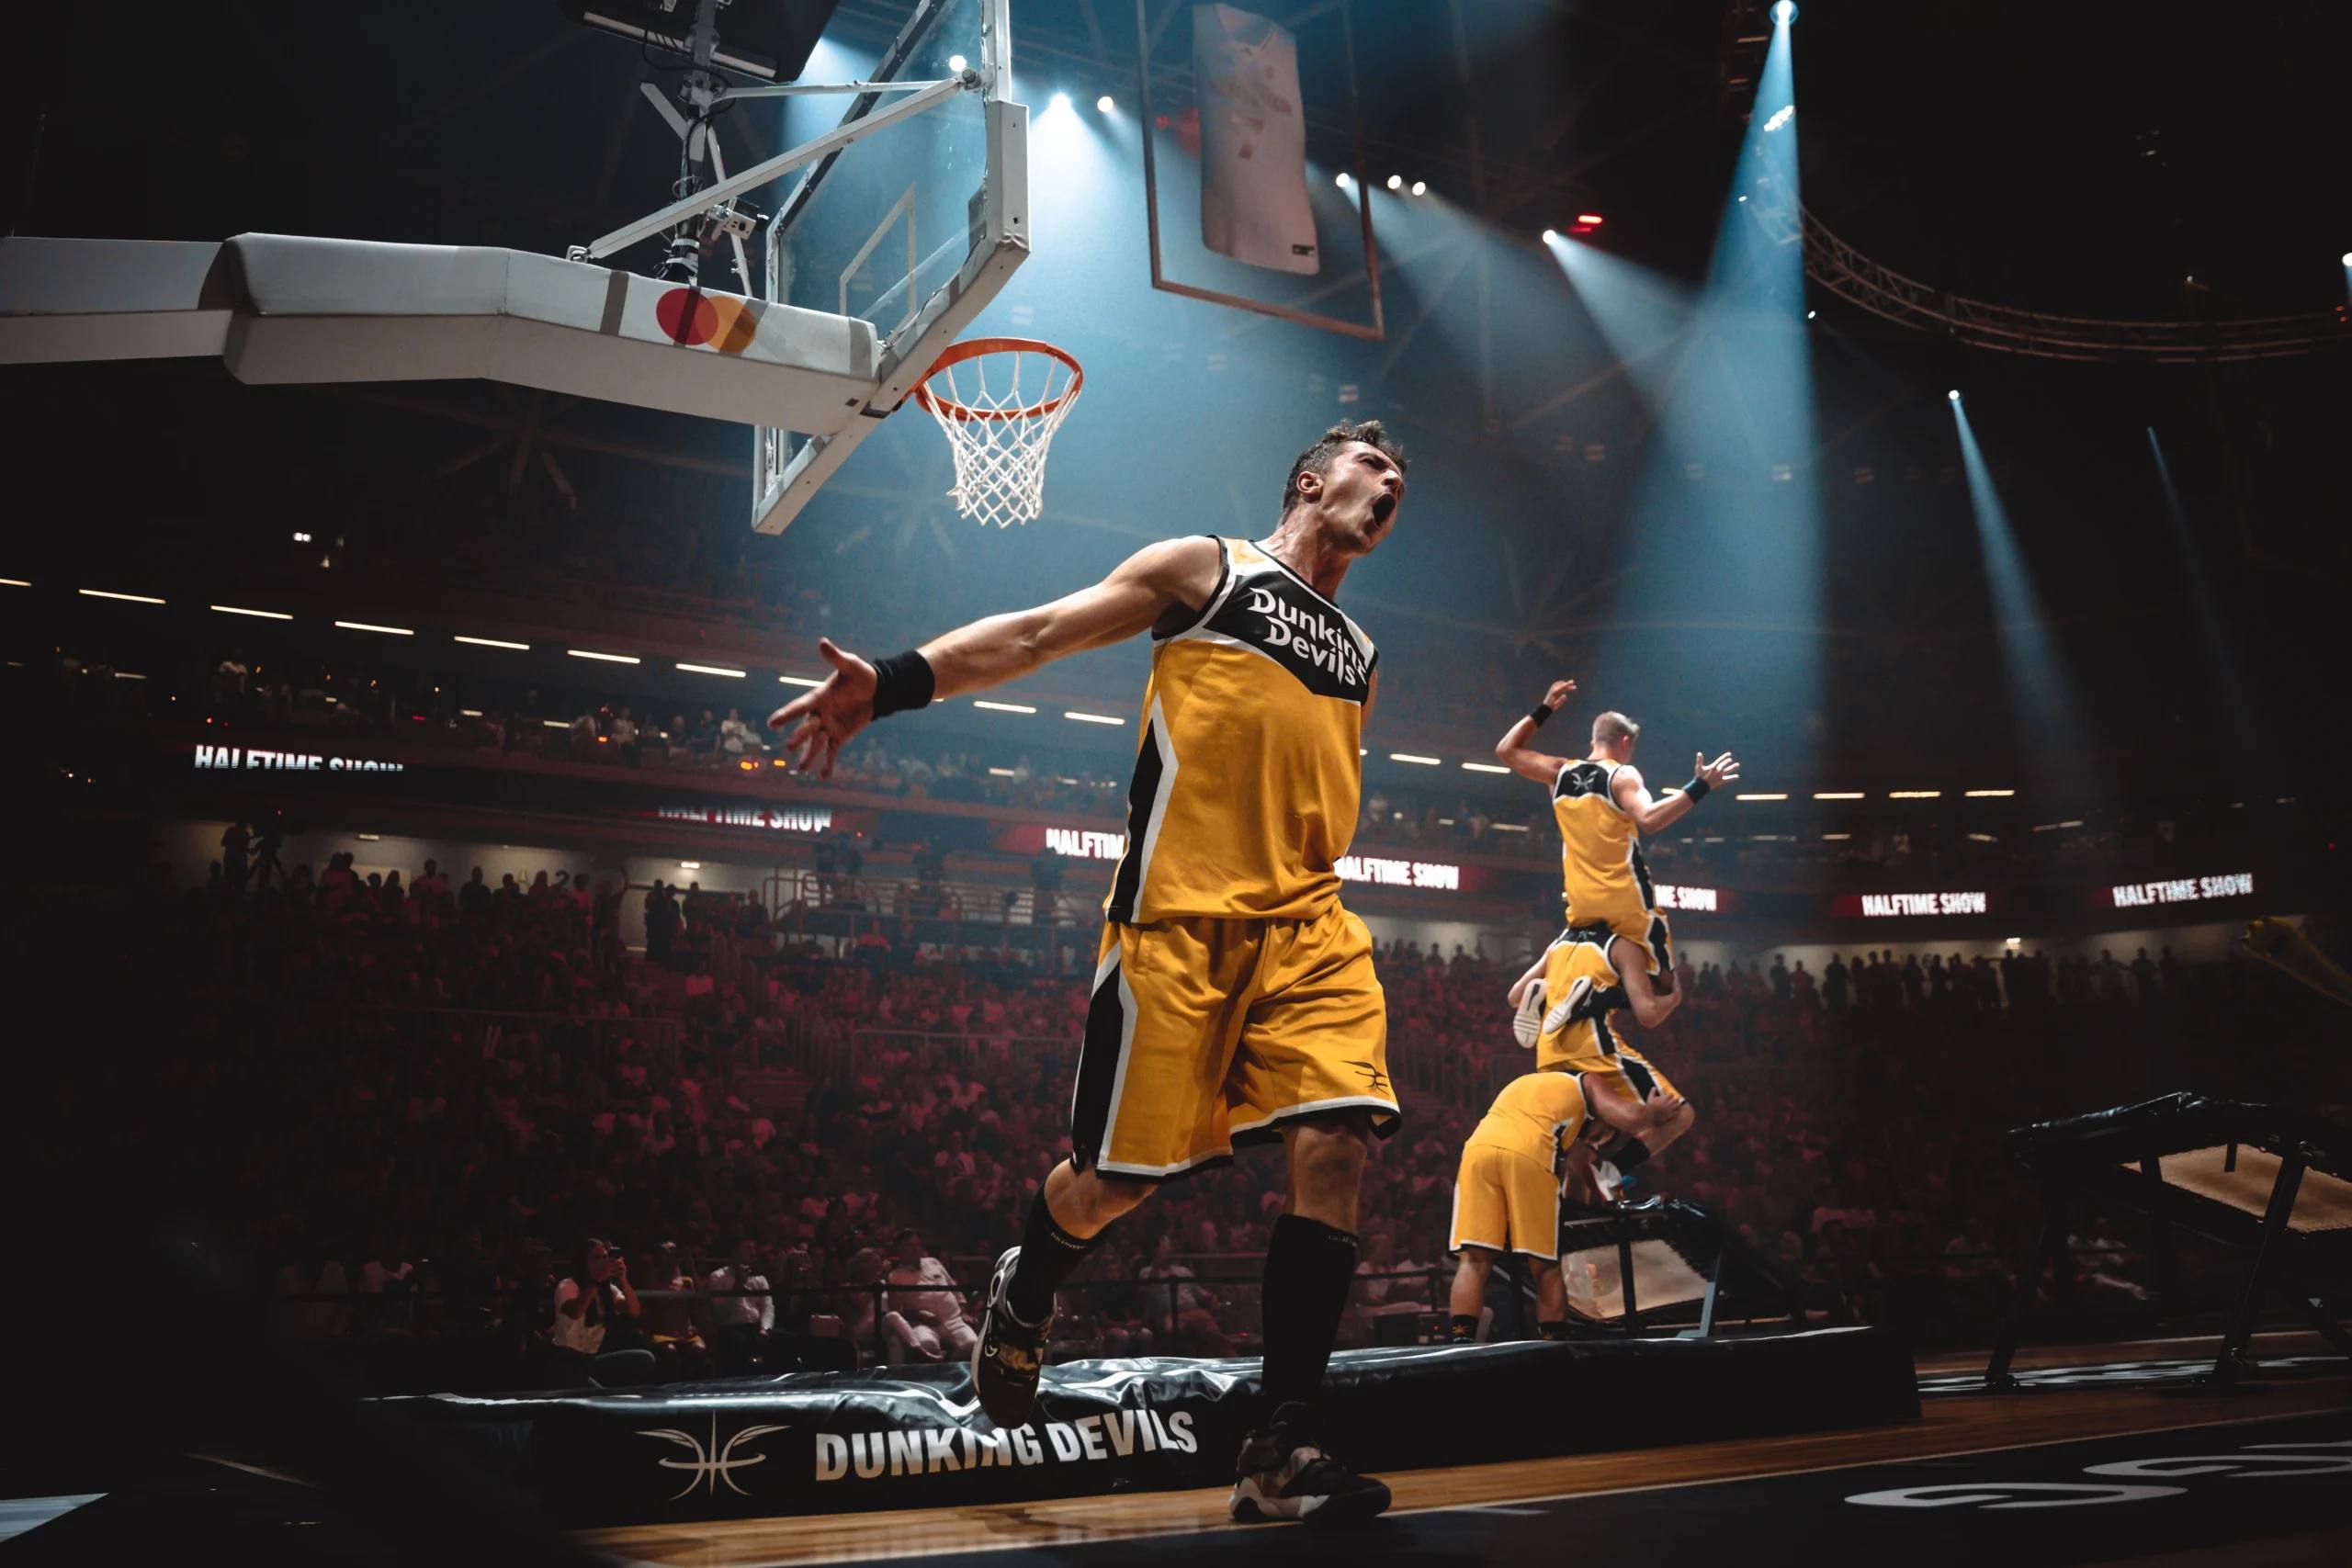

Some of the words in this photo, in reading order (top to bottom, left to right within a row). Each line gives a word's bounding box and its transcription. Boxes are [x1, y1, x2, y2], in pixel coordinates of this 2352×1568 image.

[1262, 615, 1357, 686] Devils
[1046, 828, 1125, 861] HALFTIM
[1412, 862, 1460, 890] SHOW
[2111, 878, 2200, 908] HALFTIME
[2199, 872, 2254, 899] SHOW
[1677, 886, 1717, 912] SHOW
[1860, 893, 1940, 917] HALFTIME
[1939, 891, 1986, 916] SHOW
[815, 1424, 1045, 1482] DUNKING
[1045, 1409, 1198, 1462] DEVILS
